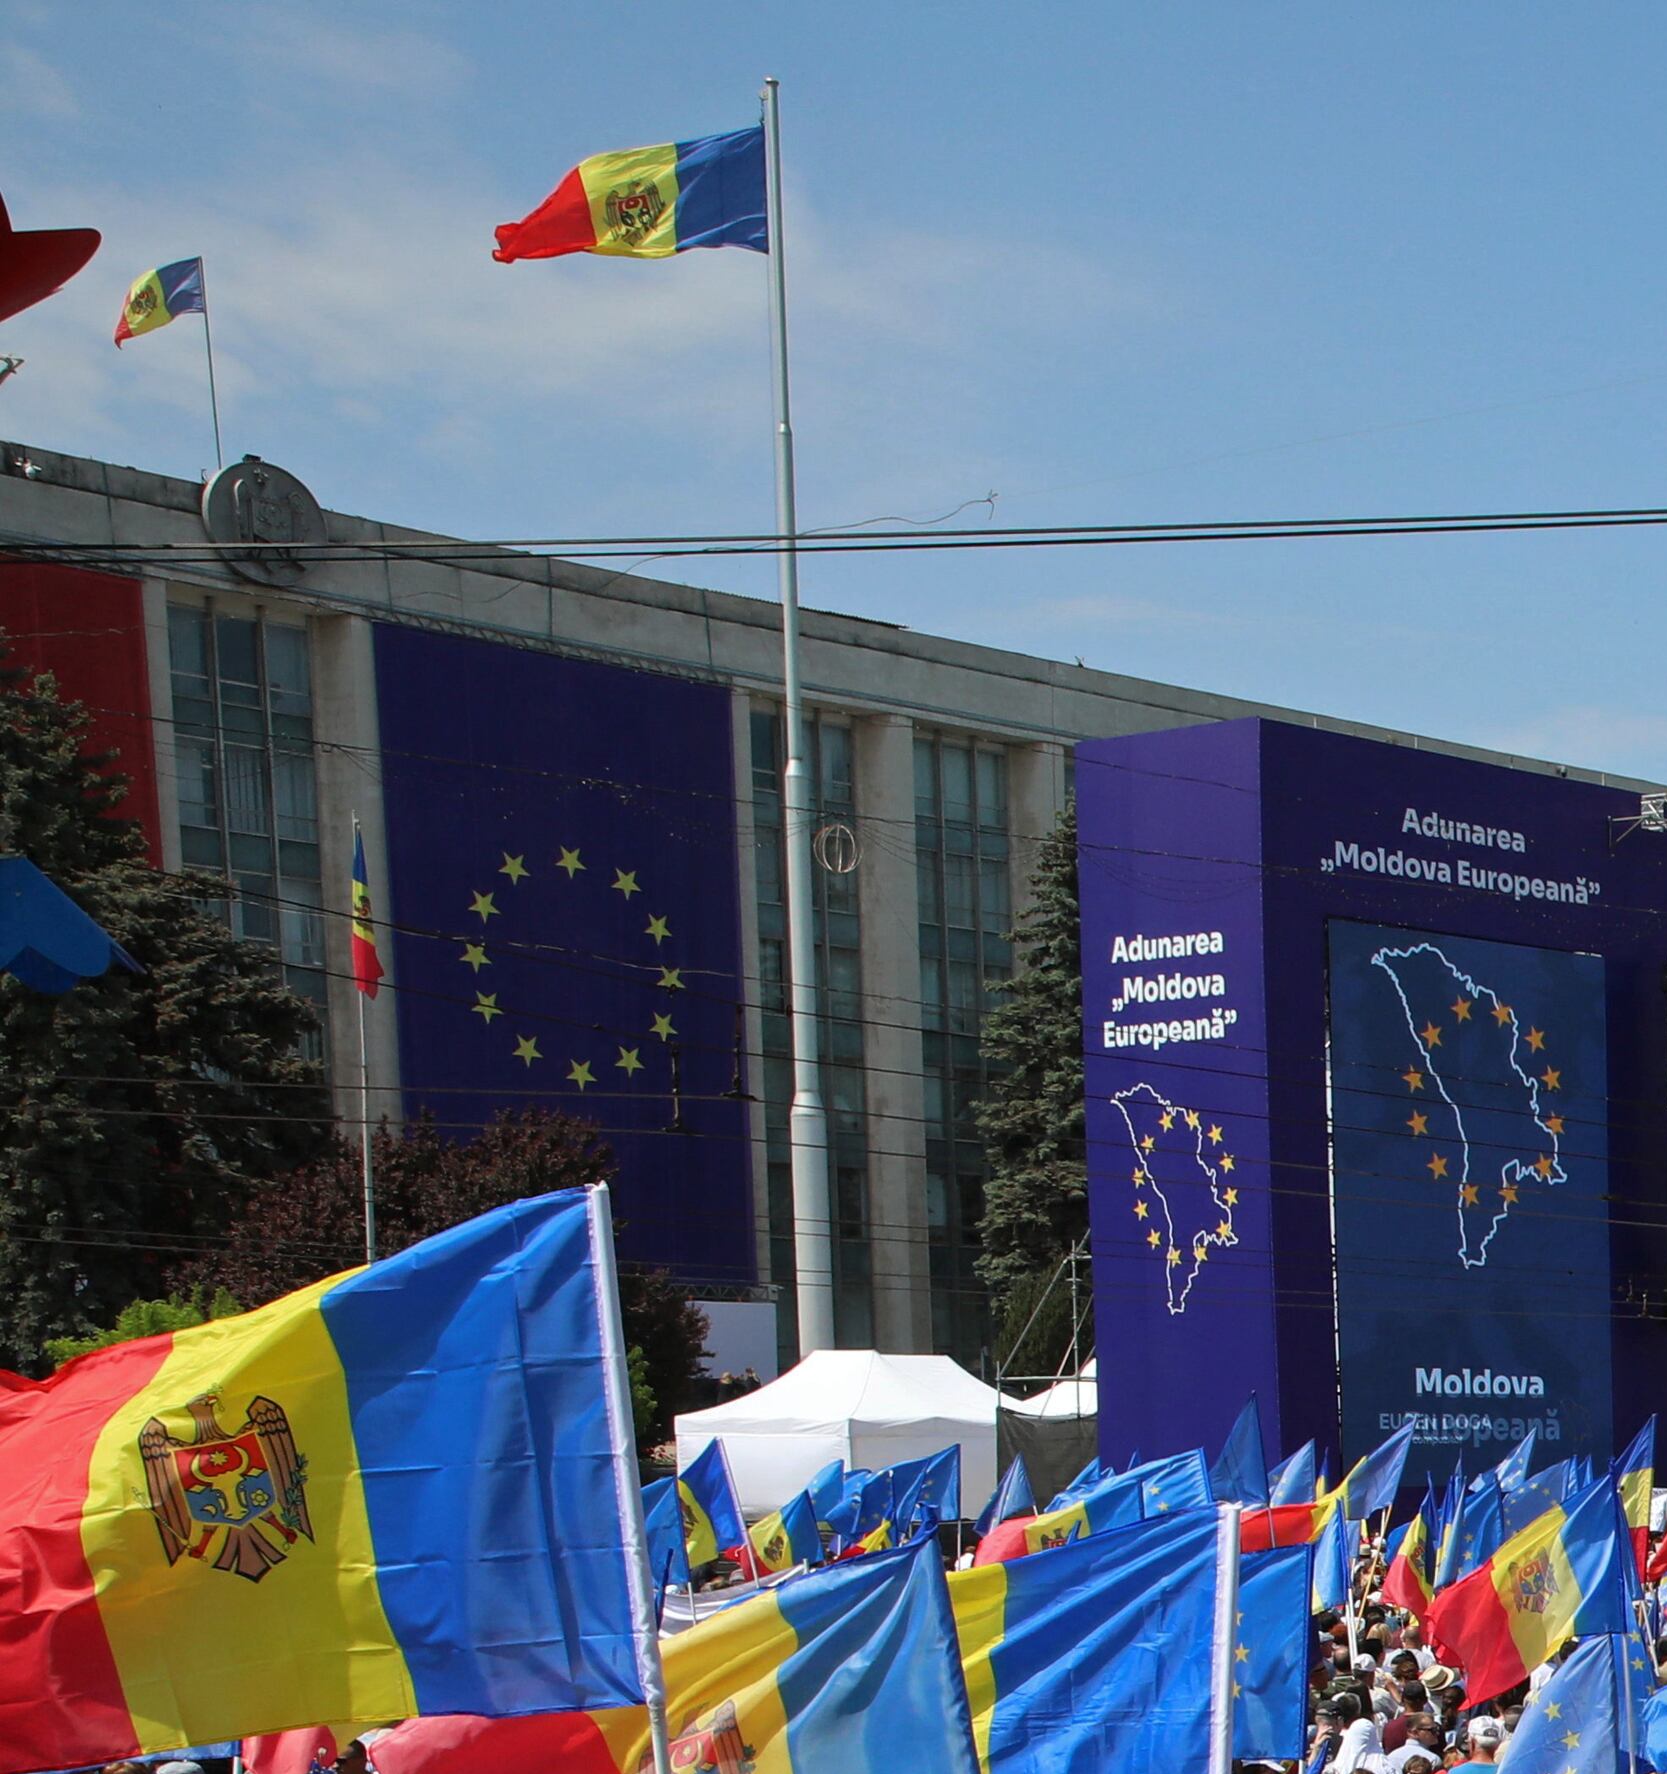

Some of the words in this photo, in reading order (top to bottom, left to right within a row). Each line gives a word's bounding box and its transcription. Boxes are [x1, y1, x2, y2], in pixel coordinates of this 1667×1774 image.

[1401, 808, 1526, 853] Adunarea
[1320, 841, 1452, 885] „Moldova
[1457, 859, 1601, 906] Europeană”
[1111, 928, 1224, 964] Adunarea
[1112, 970, 1226, 1013] „Moldova
[1103, 1010, 1237, 1050] Europeană”
[1415, 1368, 1545, 1397] Moldova
